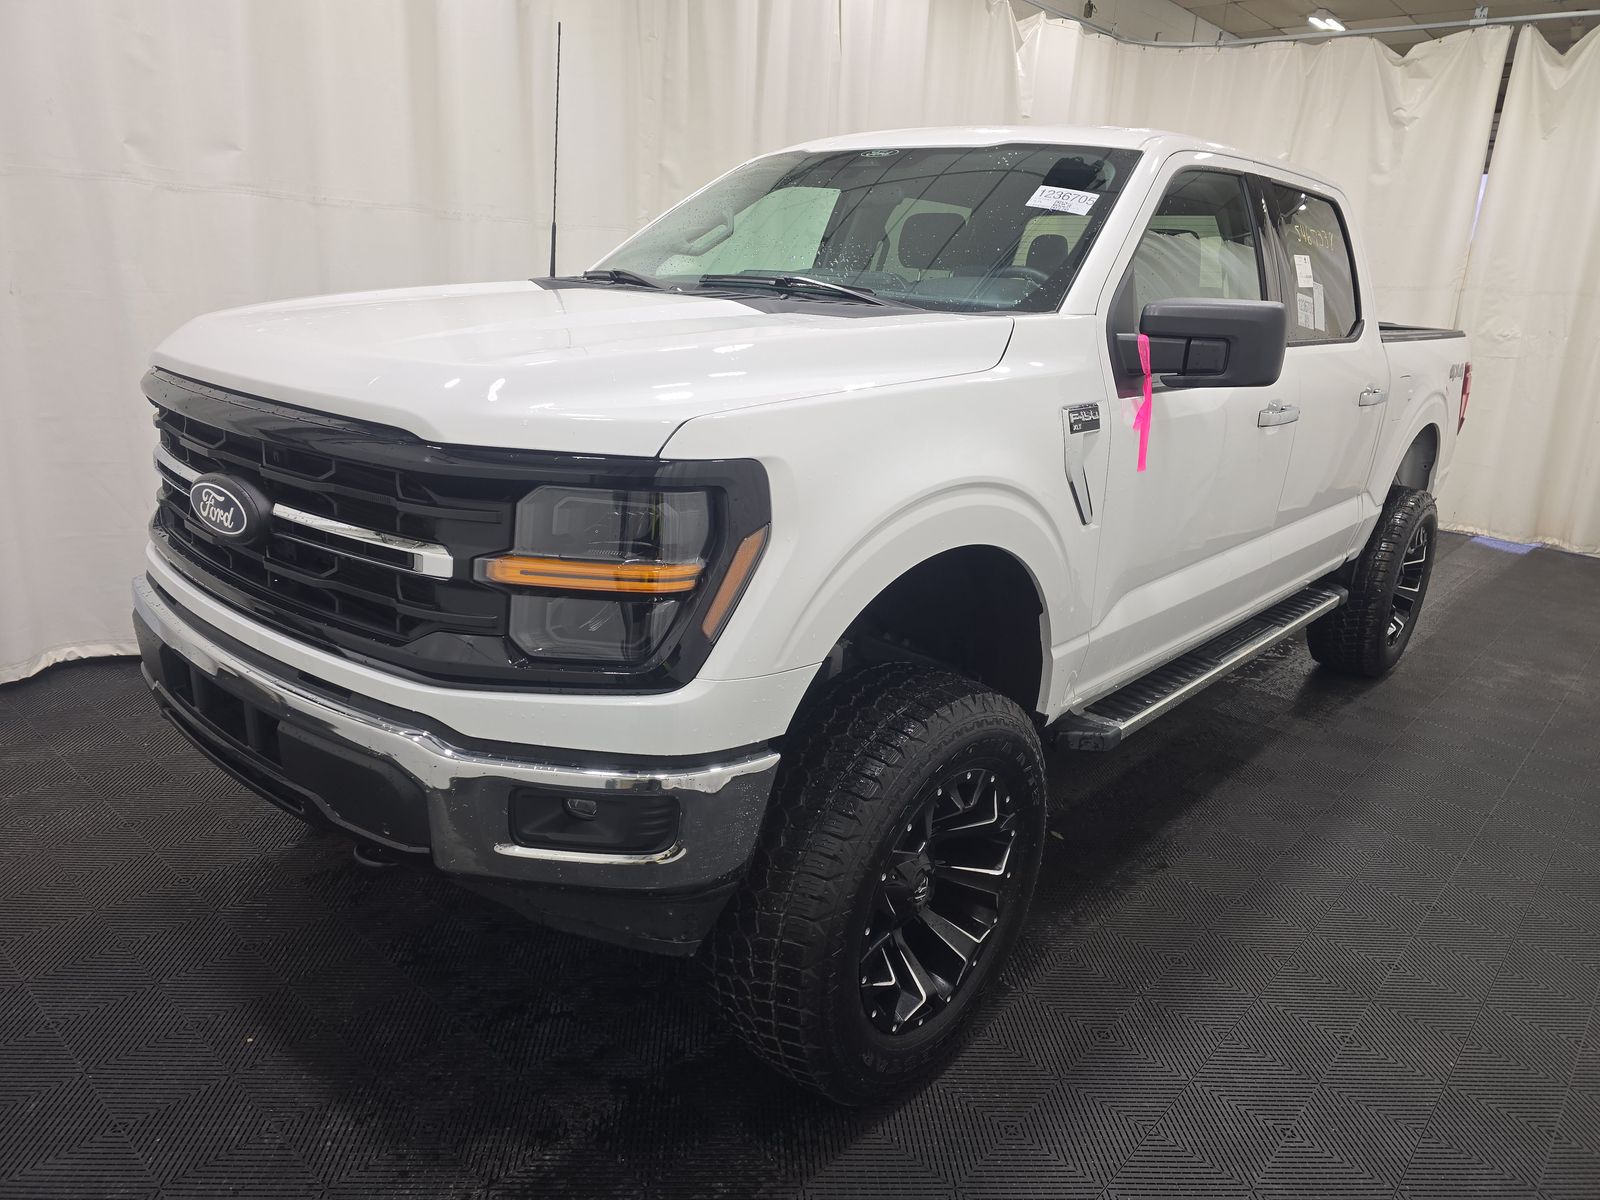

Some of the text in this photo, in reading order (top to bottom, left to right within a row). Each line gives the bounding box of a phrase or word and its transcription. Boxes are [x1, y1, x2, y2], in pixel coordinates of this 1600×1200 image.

[1039, 188, 1097, 206] 1236705
[1070, 410, 1099, 423] F-150
[200, 488, 235, 529] Ford
